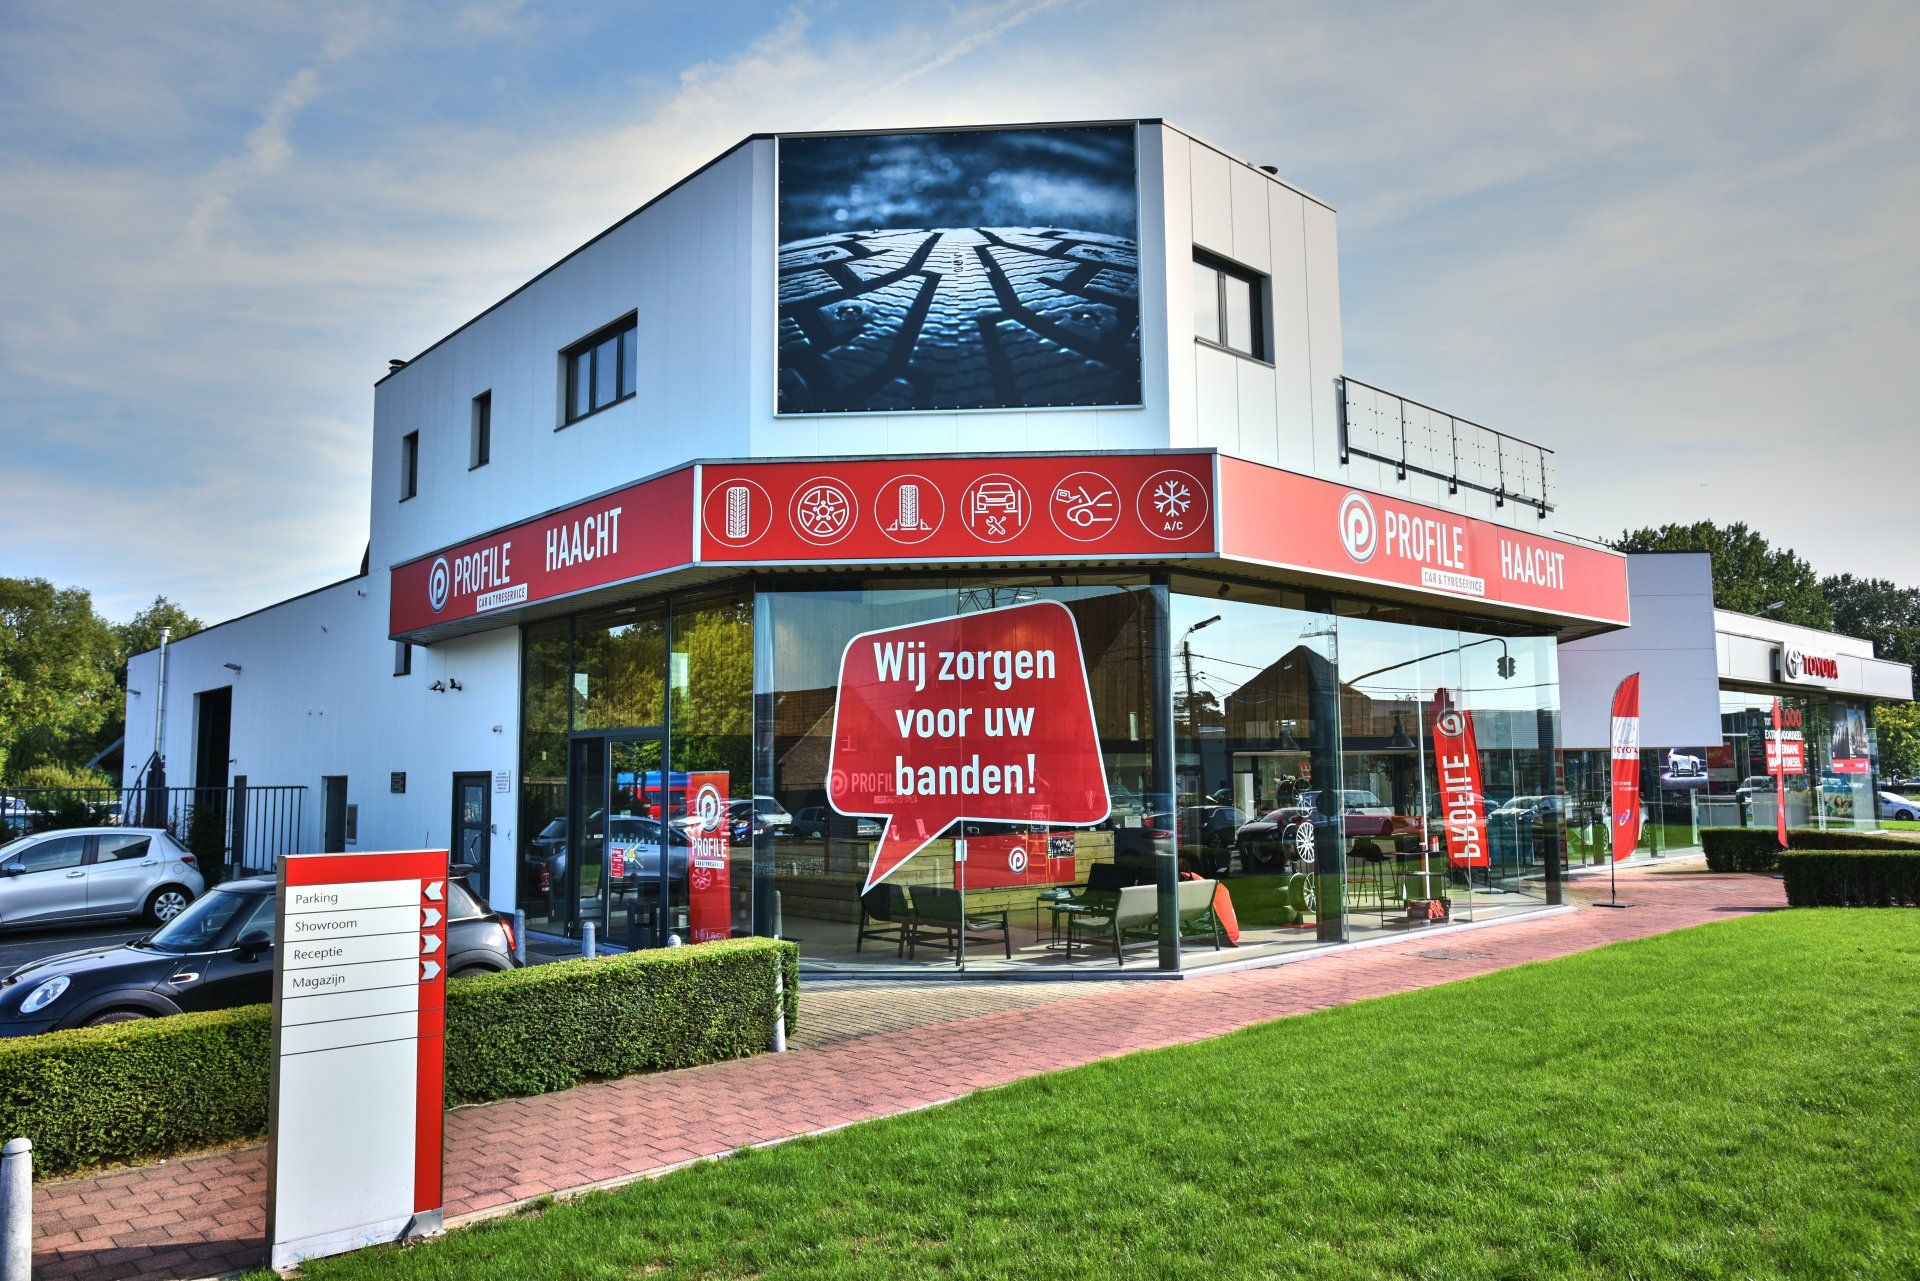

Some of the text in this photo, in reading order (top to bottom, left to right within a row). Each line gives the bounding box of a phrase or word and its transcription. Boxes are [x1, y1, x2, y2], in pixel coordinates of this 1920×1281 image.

[1164, 521, 1183, 531] A/C
[546, 507, 622, 572] HAACHT
[1385, 510, 1464, 570] PROFILE
[454, 542, 511, 597] PROFILE
[1501, 539, 1565, 590] HAACHT
[1424, 571, 1437, 583] CAR
[1443, 575, 1482, 592] TYRESERVICE
[478, 596, 488, 608] CAR
[493, 587, 525, 604] TYRESERVICE
[873, 641, 1055, 692] Wij zorgen
[1802, 655, 1838, 679] TOYOTA
[895, 707, 1035, 738] voor uw
[851, 773, 895, 793] PROFIL
[895, 753, 1036, 796] banden!
[691, 837, 727, 858] PROFILE
[295, 893, 338, 905] Parking
[295, 920, 357, 932] Showroom
[294, 947, 343, 960] Receptie
[292, 974, 345, 989] Magazijn
